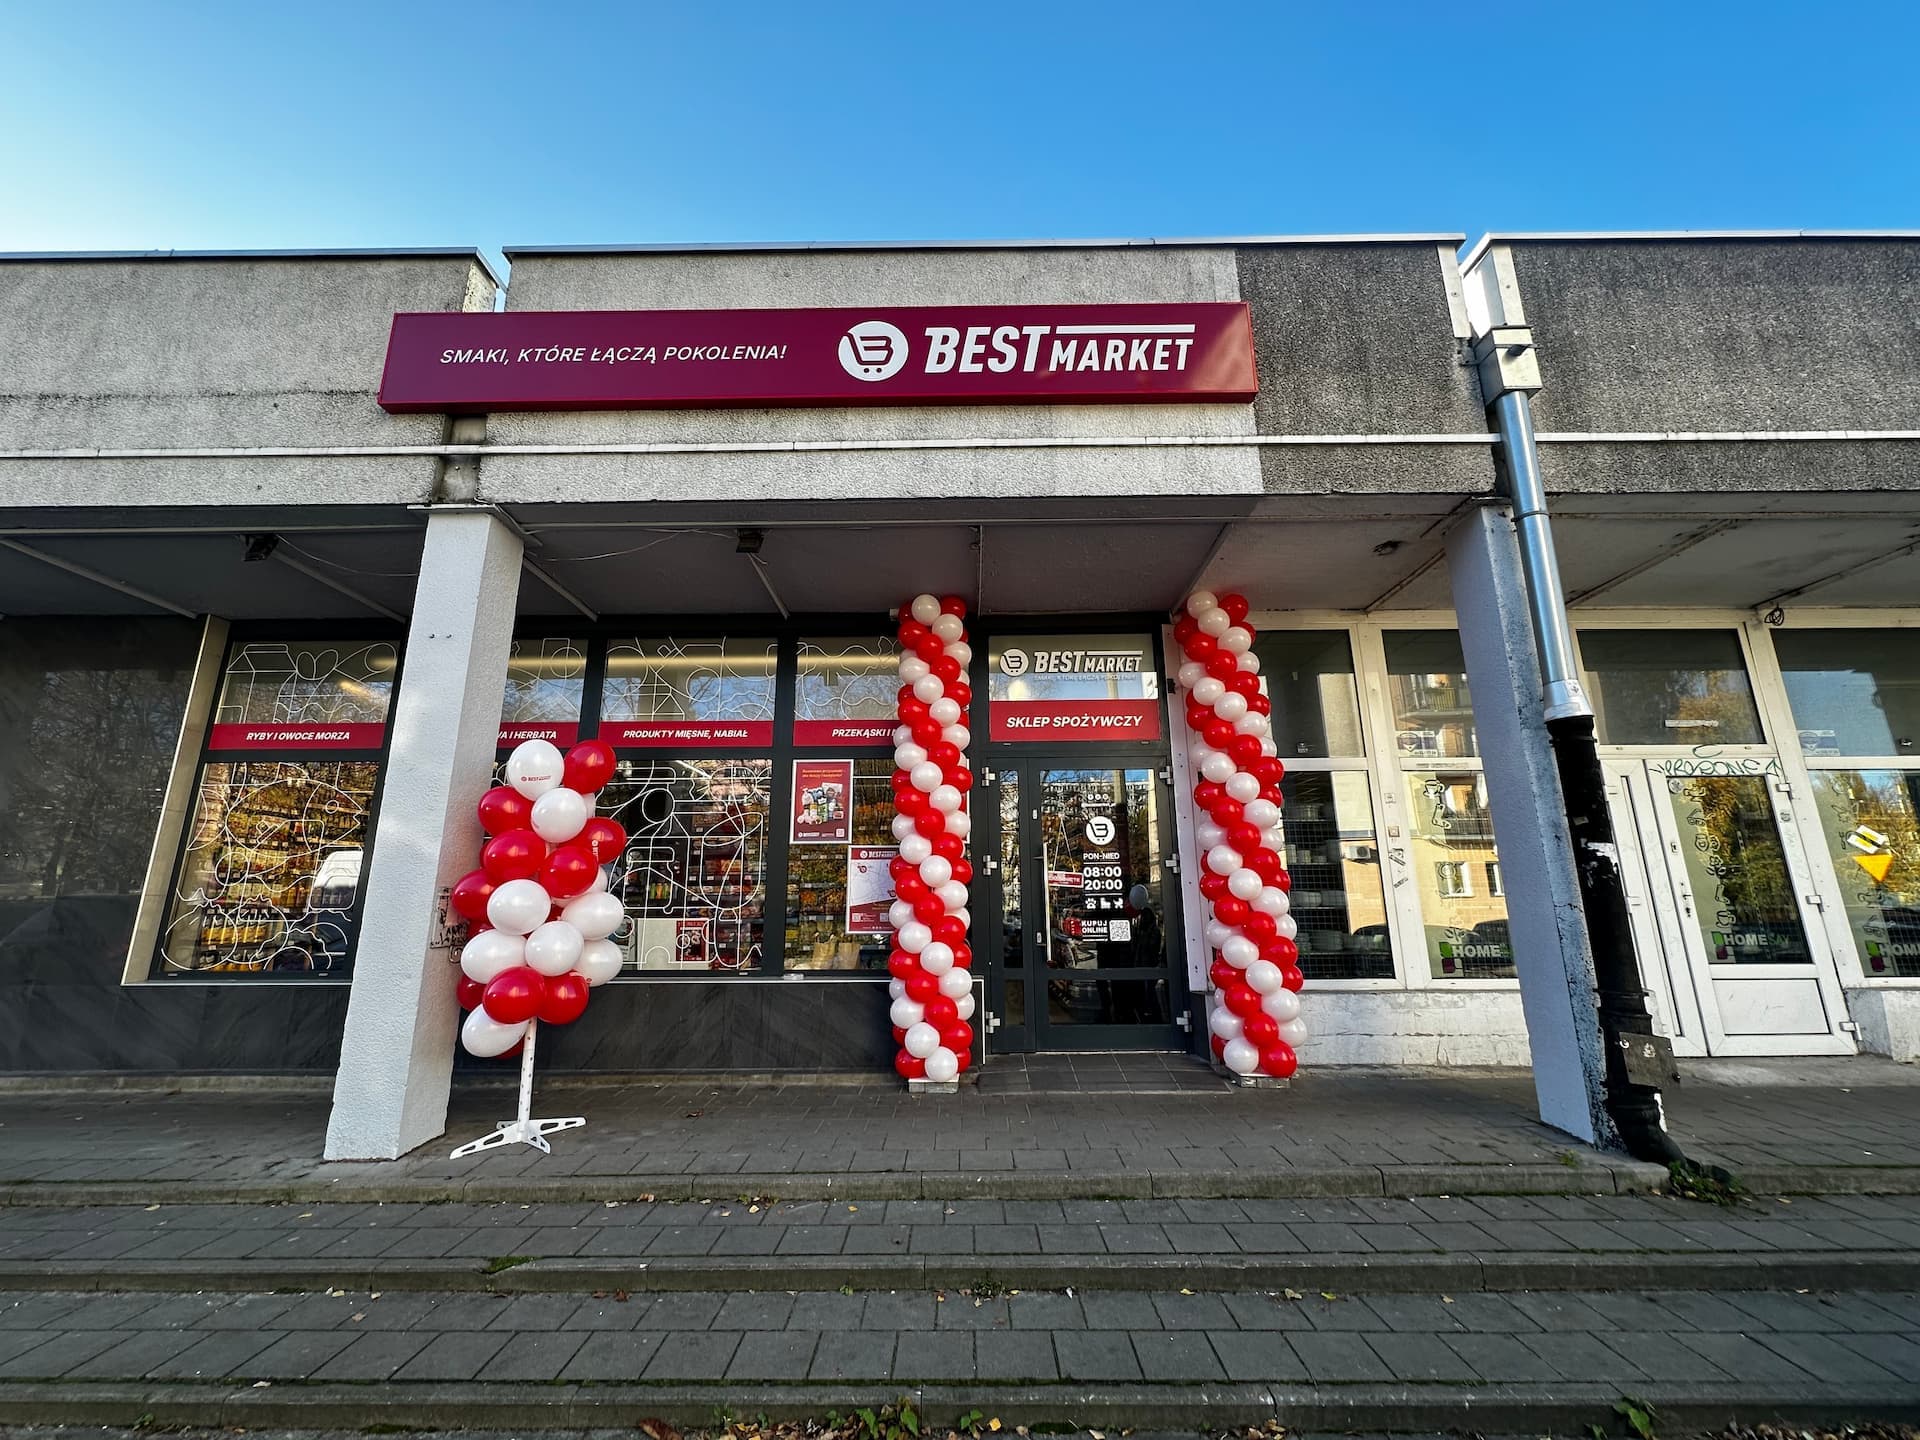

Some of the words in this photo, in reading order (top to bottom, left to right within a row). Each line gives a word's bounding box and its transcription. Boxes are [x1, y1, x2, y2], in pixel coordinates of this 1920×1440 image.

[440, 348, 509, 365] SMAKI,
[517, 344, 586, 362] KTÓRE
[590, 346, 656, 364] ŁĄCZĄ
[663, 345, 788, 361] POKOLENIA!
[924, 325, 1051, 374] BEST
[1048, 338, 1194, 374] MARKET
[1034, 650, 1086, 673] BEST
[1084, 656, 1143, 673] MARKET
[1006, 716, 1050, 728] SKLEP
[1052, 713, 1143, 728] SPOŻYWCZY
[246, 732, 274, 741] RYBY
[278, 732, 315, 741] OWOCE
[314, 731, 350, 740] MORZA
[514, 731, 557, 739] HERBATA
[623, 730, 674, 738] PRODUKTY
[674, 729, 711, 739] MIĘSNE,
[713, 729, 748, 738] NABIAŁ
[832, 728, 886, 738] PRZEKĄSKI
[1083, 852, 1120, 860] PON-NIED
[1083, 866, 1122, 877] 08:00
[1084, 879, 1123, 890] 20:00
[1081, 926, 1108, 934] ONLINE
[1879, 943, 1920, 956] HOM
